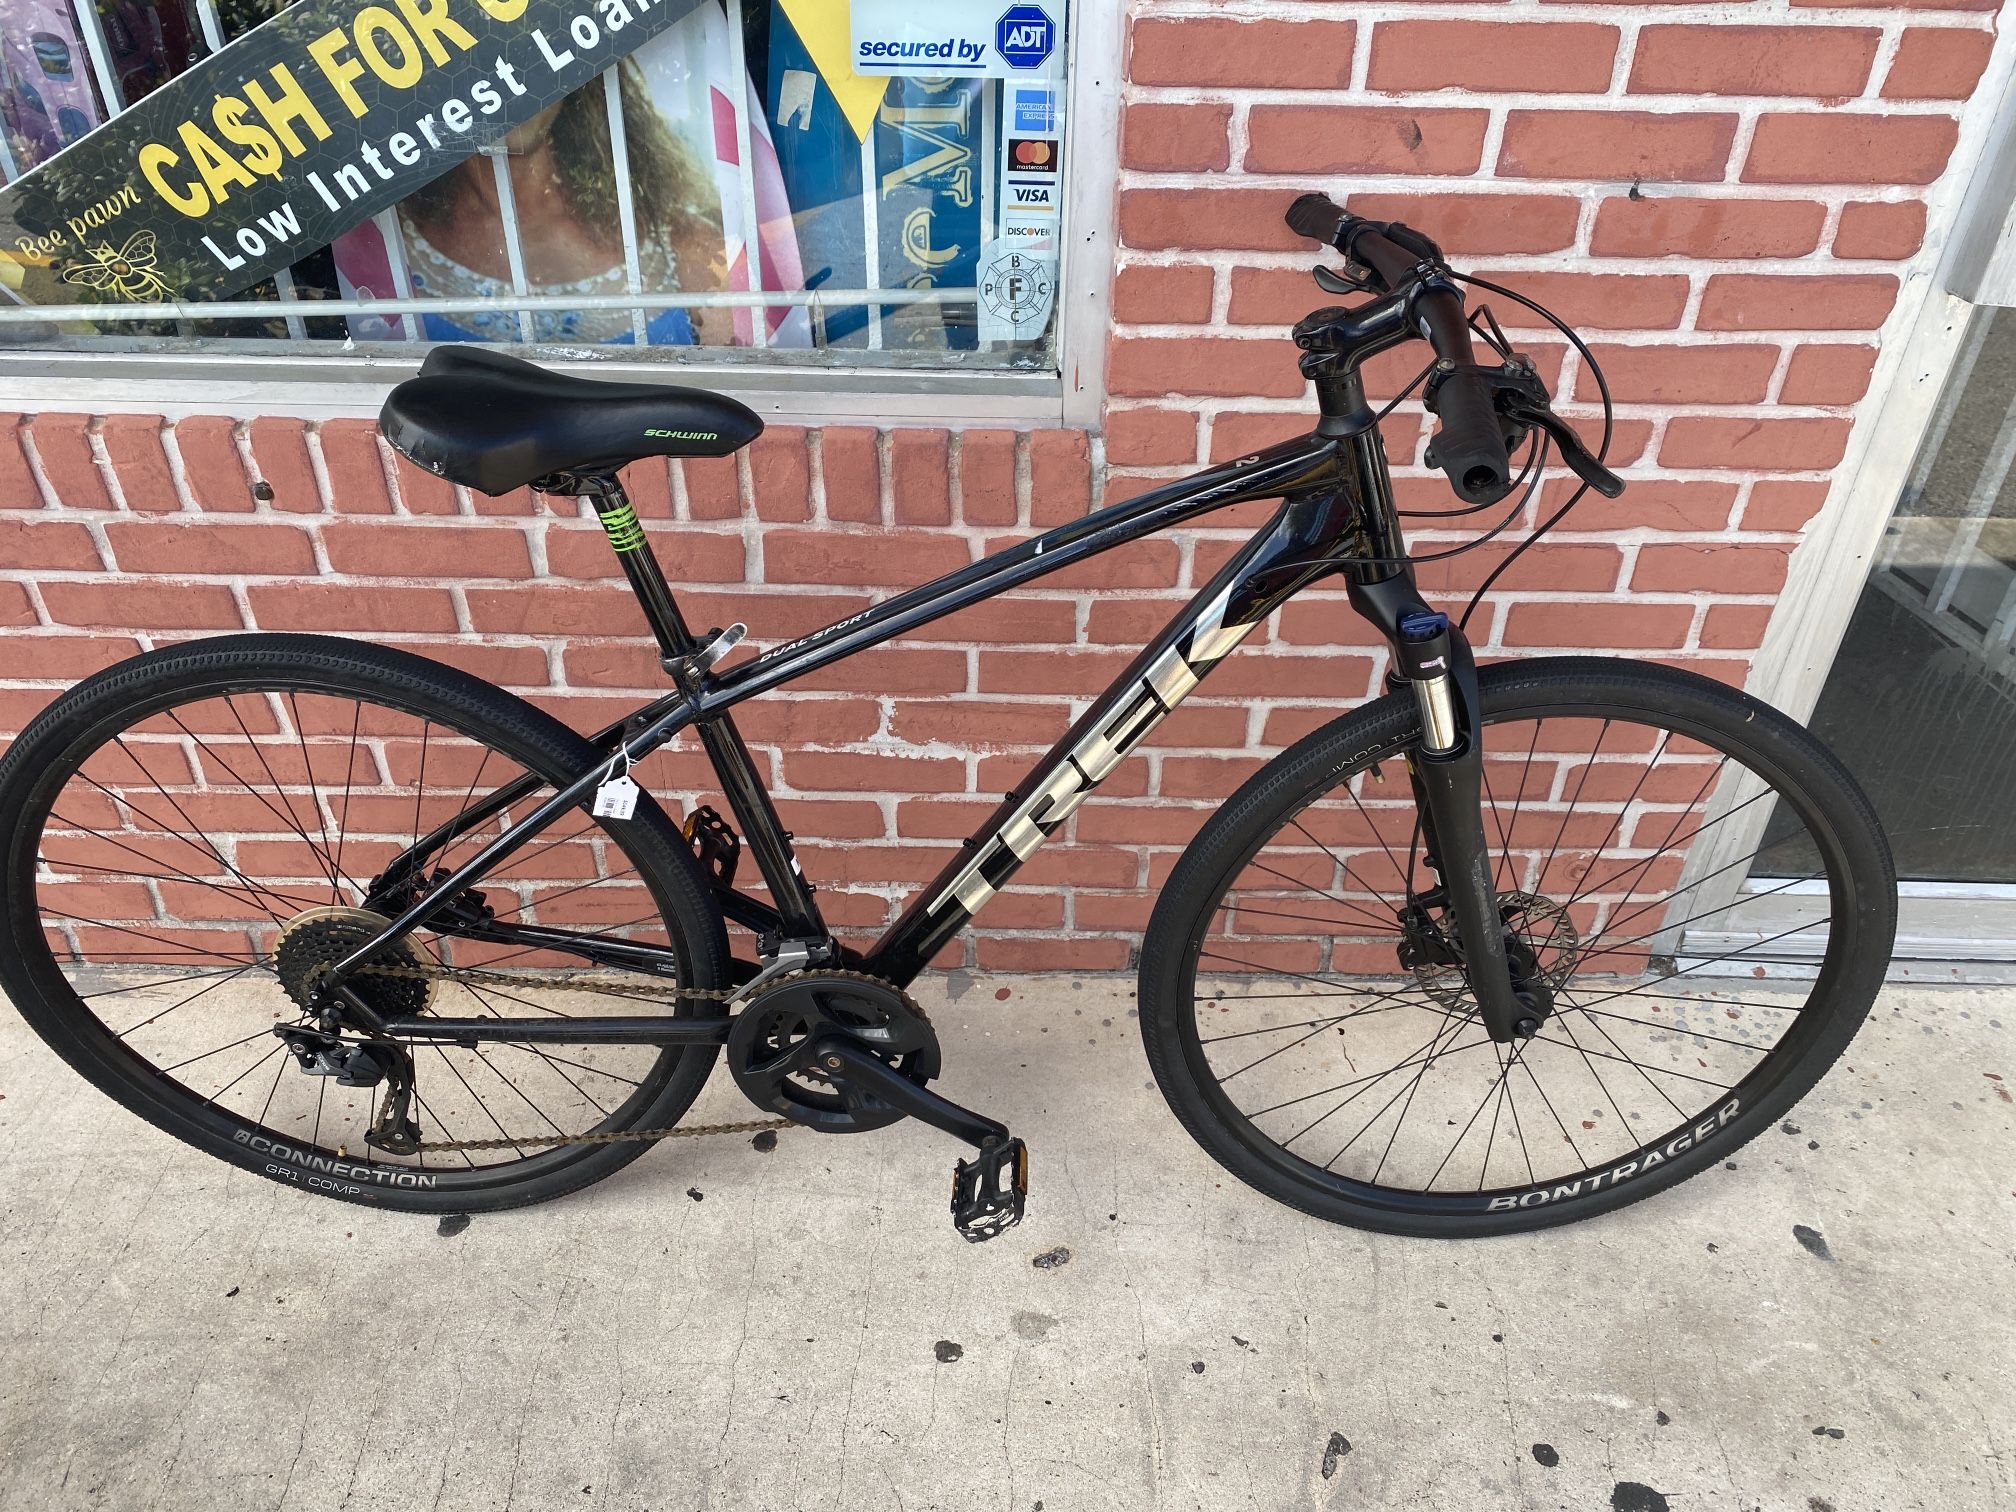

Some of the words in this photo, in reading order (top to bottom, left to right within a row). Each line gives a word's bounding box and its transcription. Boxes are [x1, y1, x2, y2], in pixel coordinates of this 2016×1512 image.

[1006, 25, 1046, 48] ADT
[859, 39, 954, 58] secured
[957, 39, 986, 62] by
[138, 62, 334, 218] CA$H
[306, 0, 479, 119] FOR
[200, 202, 302, 271] Low
[306, 55, 528, 213] Interest
[1013, 188, 1050, 202] VISA
[15, 229, 67, 262] Bee
[66, 185, 142, 244] pawn
[1007, 227, 1051, 236] DISCOVER
[1011, 255, 1021, 268] B
[984, 283, 993, 296] P
[1009, 278, 1022, 301] F
[1038, 282, 1047, 295] C
[1010, 310, 1020, 323] C
[643, 428, 718, 440] SCHWINN
[1235, 455, 1260, 468] 2
[759, 639, 808, 663] DUAL
[811, 608, 876, 641] SPORT
[926, 579, 1260, 917] TREK
[249, 1135, 437, 1189] CONNECTION
[1485, 1098, 1741, 1213] BONTRAGER
[265, 1163, 299, 1182] GR1
[308, 1176, 361, 1195] COMP
